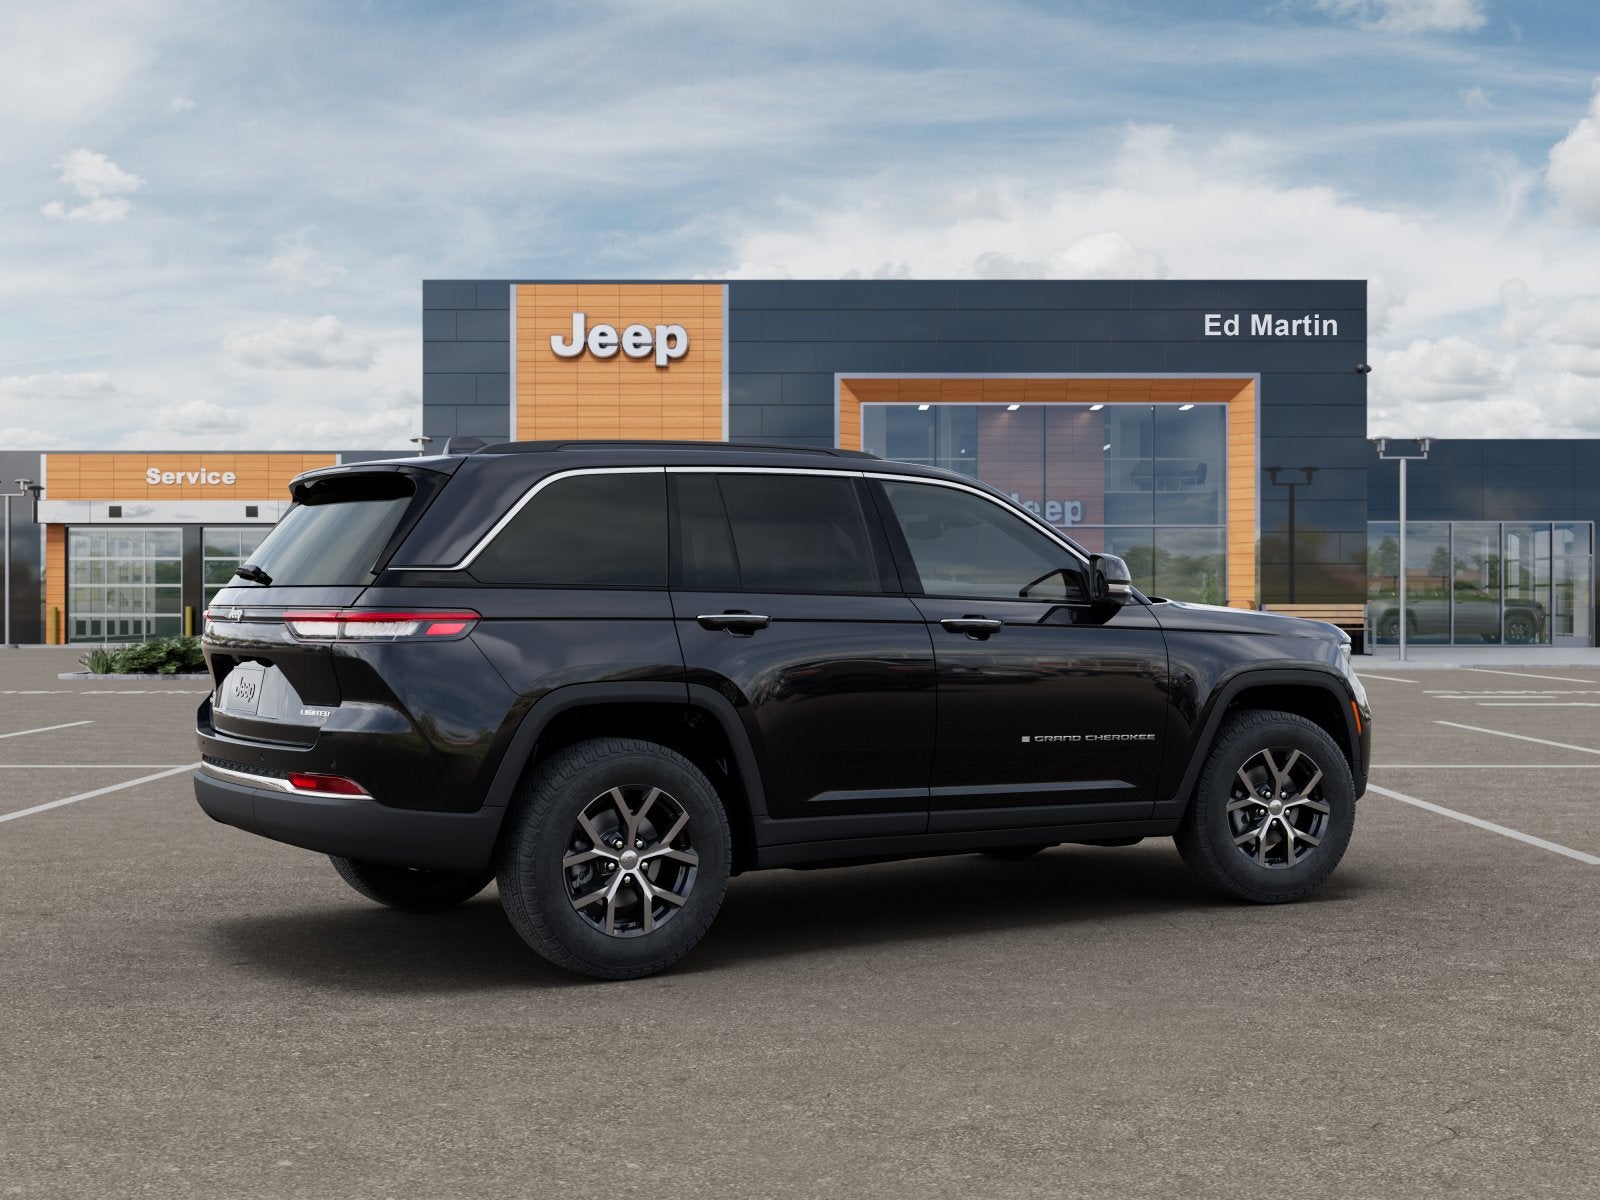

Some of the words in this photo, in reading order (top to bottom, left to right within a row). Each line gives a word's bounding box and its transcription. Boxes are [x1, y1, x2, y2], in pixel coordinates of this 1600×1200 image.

[1204, 313, 1239, 336] Ed
[1251, 313, 1338, 336] Martin
[550, 312, 689, 367] Jeep
[146, 467, 236, 485] Service
[1010, 493, 1084, 527] eep
